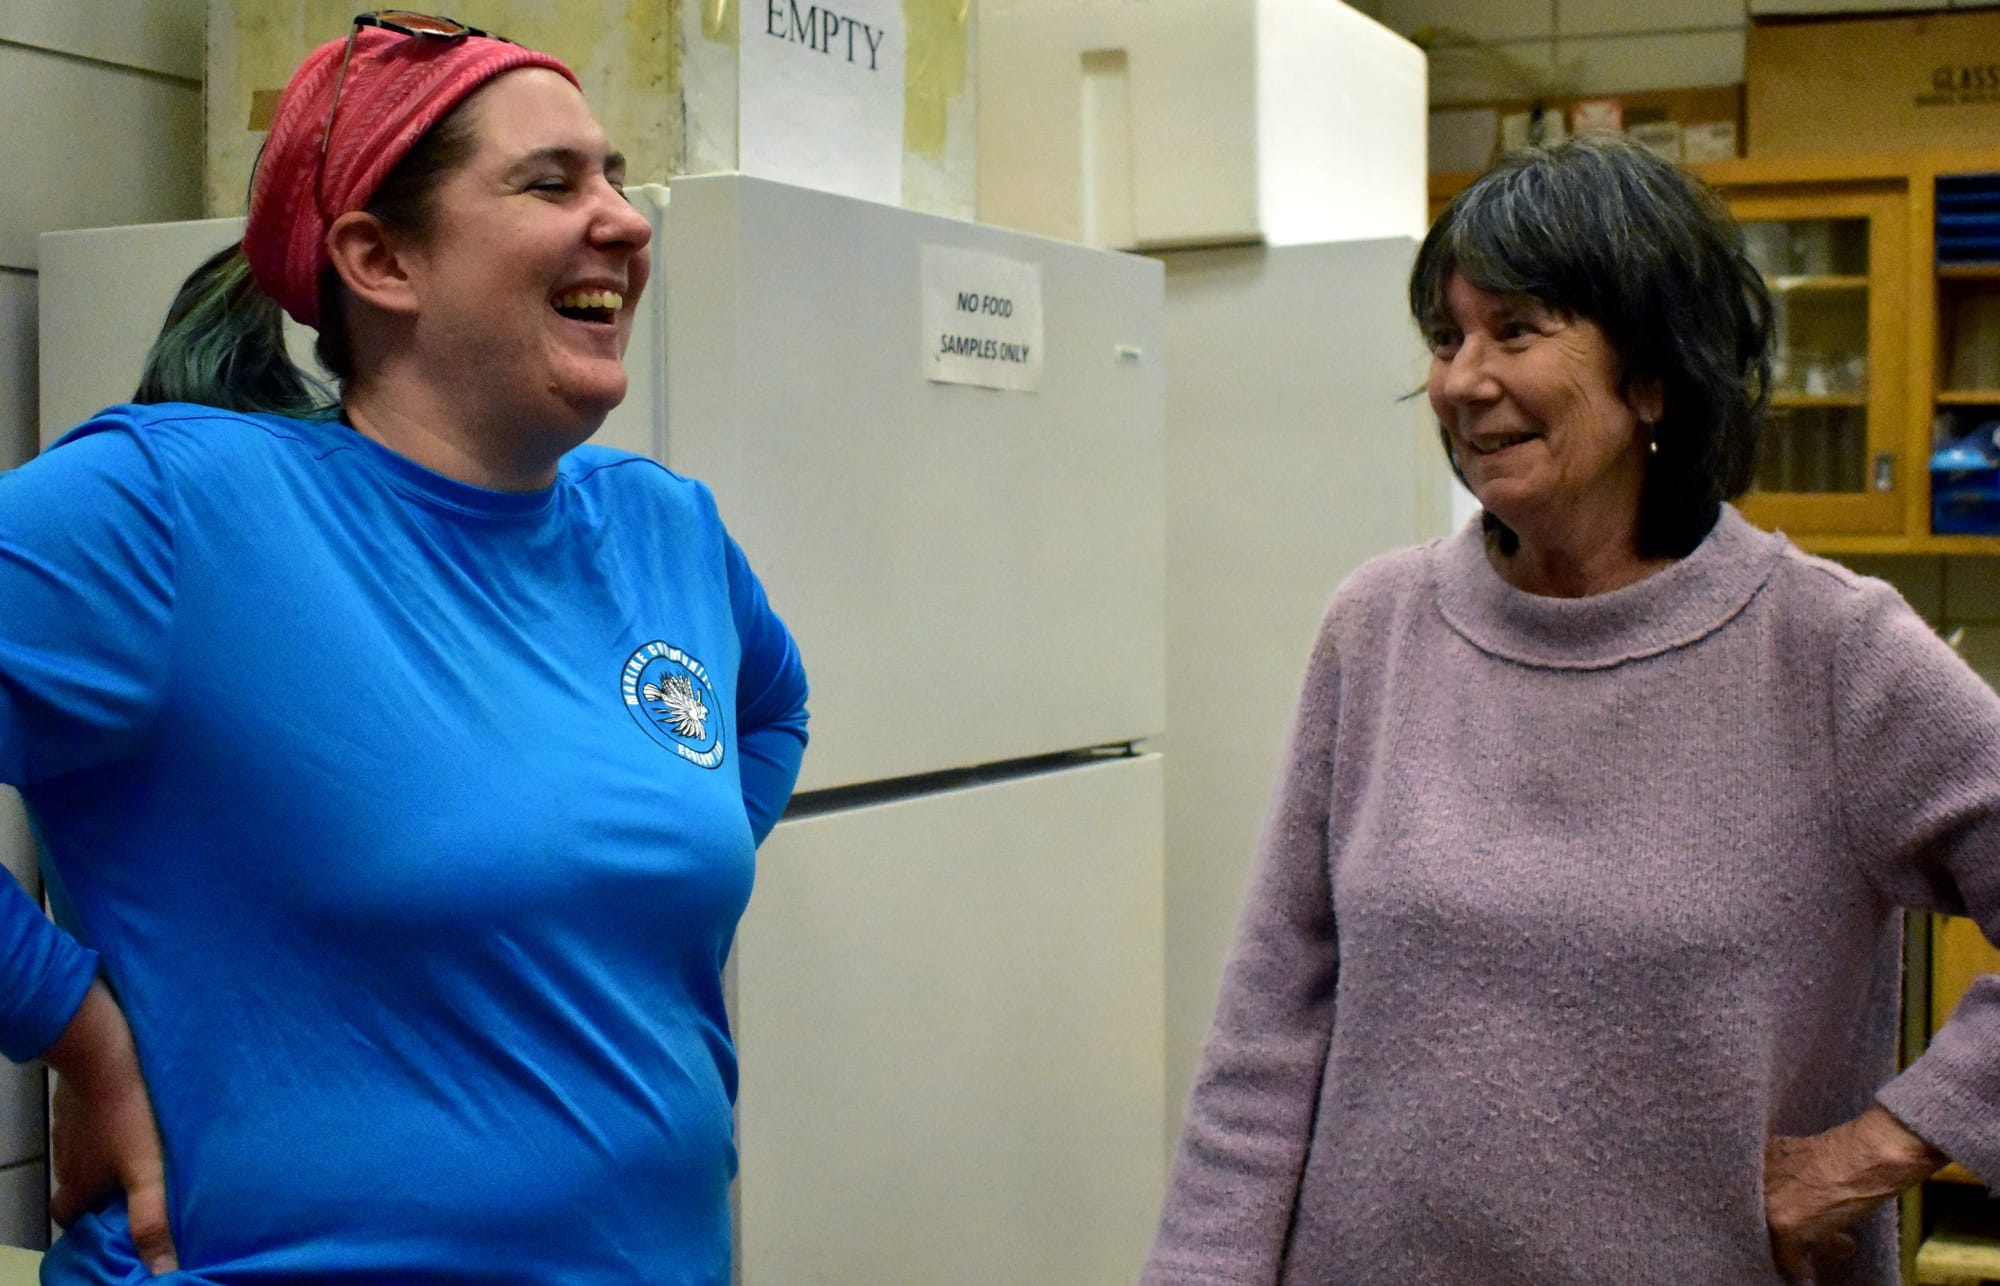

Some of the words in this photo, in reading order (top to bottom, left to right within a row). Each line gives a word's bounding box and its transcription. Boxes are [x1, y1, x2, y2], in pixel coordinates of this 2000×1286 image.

[765, 0, 884, 71] EMPTY
[957, 291, 979, 313] NO
[982, 295, 1013, 319] FOOD
[941, 333, 997, 360] SAMPLES
[1000, 341, 1030, 364] ONLY
